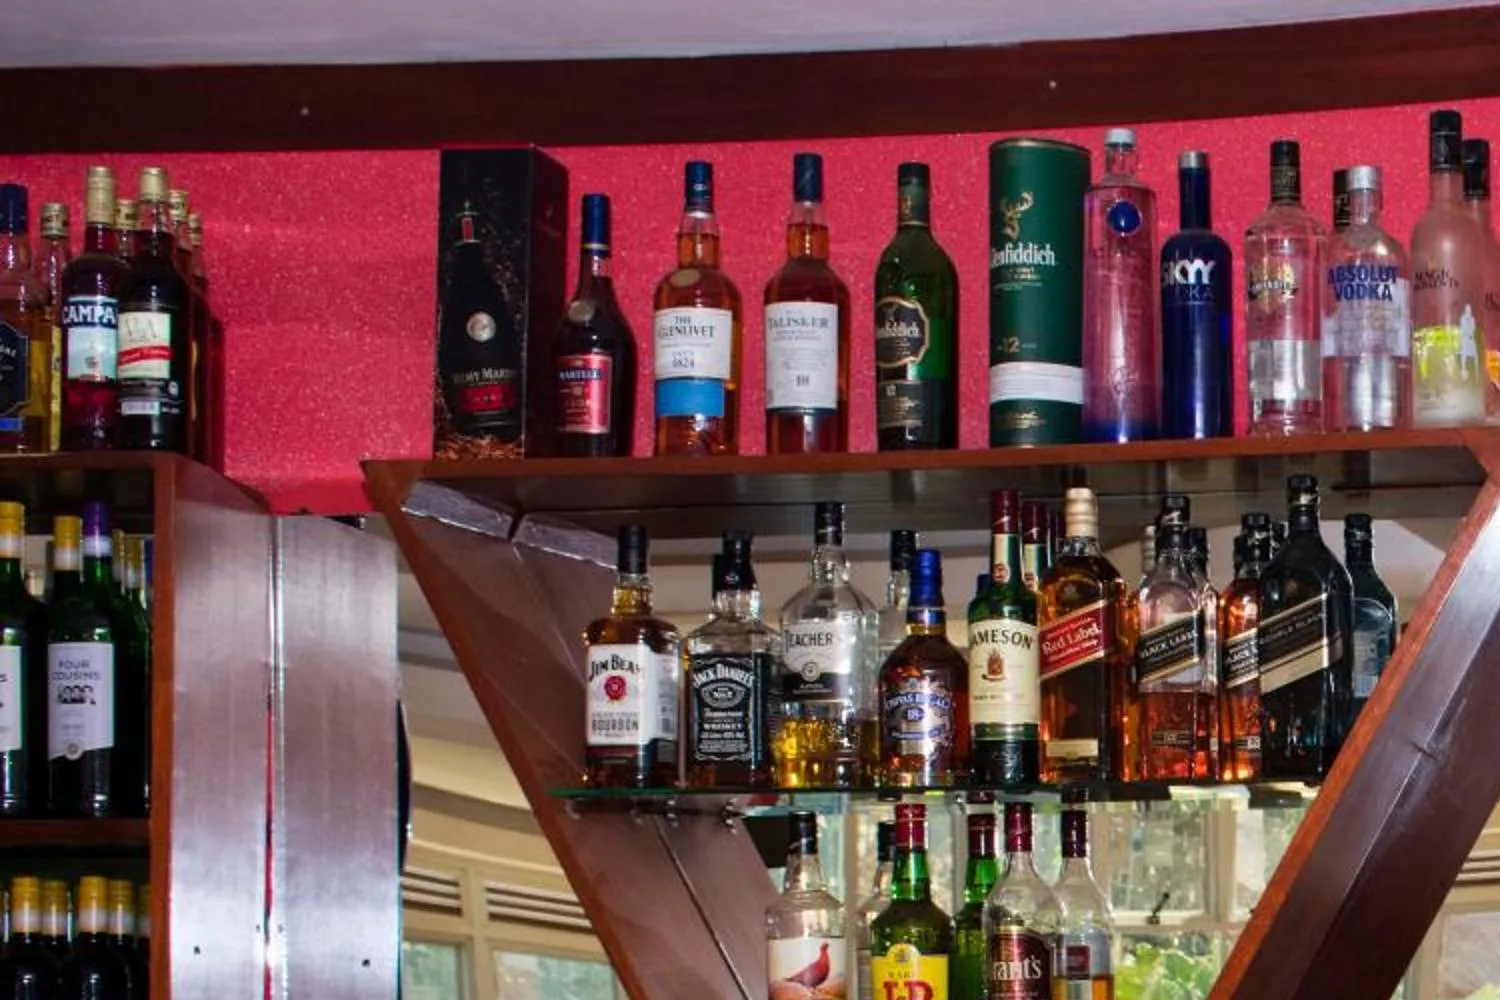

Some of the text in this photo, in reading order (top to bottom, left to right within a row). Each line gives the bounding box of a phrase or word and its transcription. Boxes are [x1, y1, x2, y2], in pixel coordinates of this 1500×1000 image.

[991, 244, 1057, 268] enfiddich
[1161, 258, 1216, 288] SKYY
[1328, 264, 1399, 286] ABSOLUT
[1334, 283, 1393, 301] VODKA
[63, 305, 118, 326] CAMPA
[767, 316, 831, 330] TALISKER
[971, 628, 1033, 651] JAMESON
[589, 660, 609, 682] JIM
[692, 666, 715, 688] JACK
[992, 955, 1042, 981] rant's
